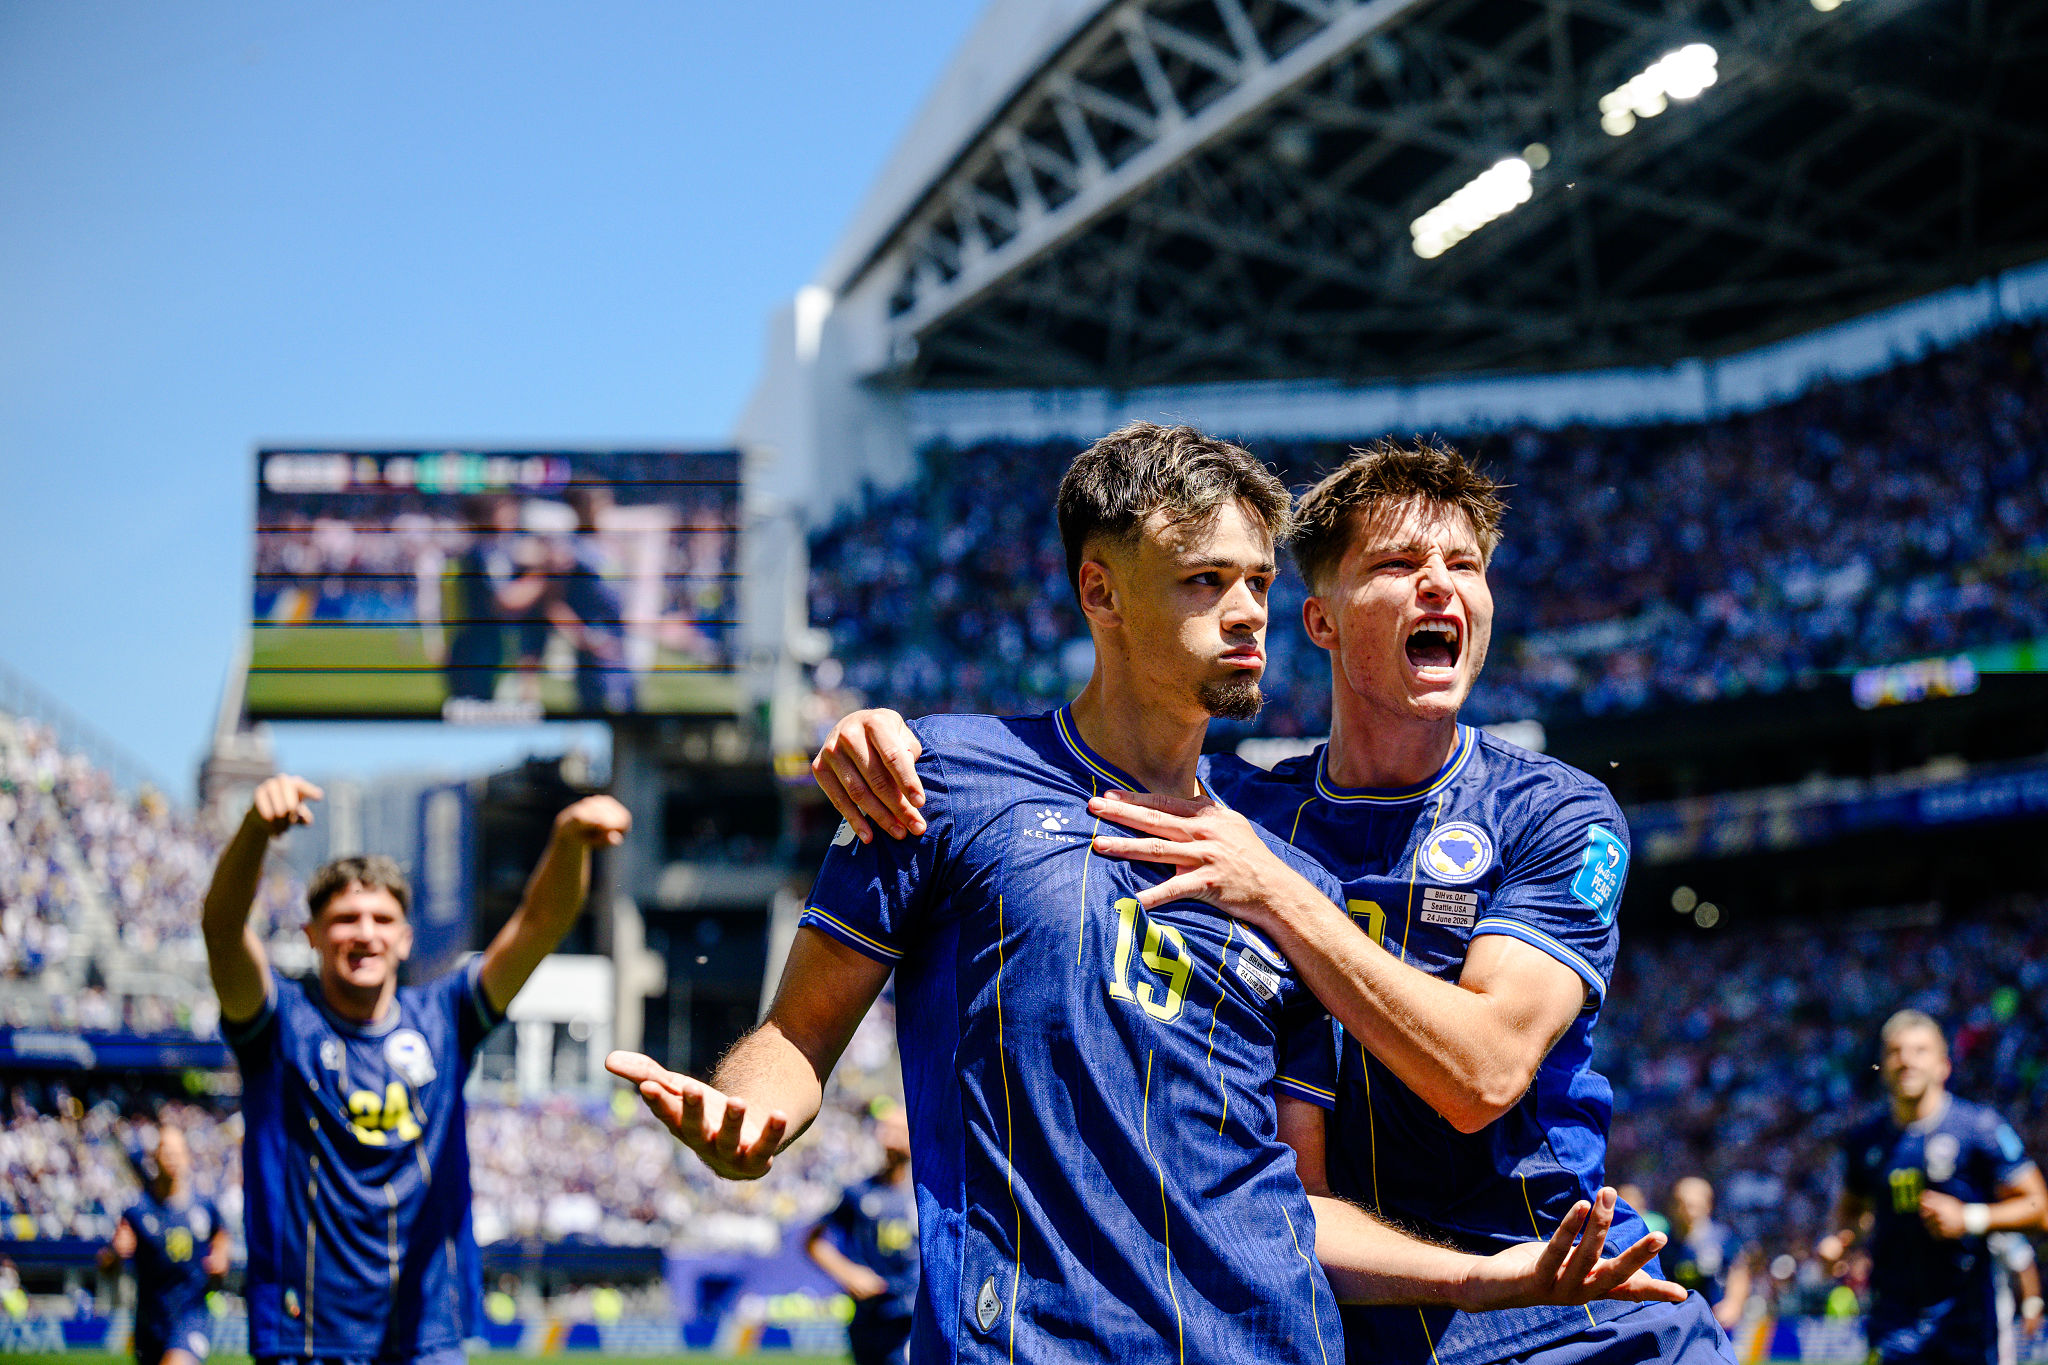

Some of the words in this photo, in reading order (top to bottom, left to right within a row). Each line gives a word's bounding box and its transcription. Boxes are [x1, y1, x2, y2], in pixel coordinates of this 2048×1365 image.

[1023, 828, 1077, 843] KELME
[1595, 860, 1611, 881] Unite
[1590, 874, 1613, 901] PEACE
[1434, 891, 1446, 899] BIH
[1454, 893, 1467, 902] QAT
[1591, 891, 1604, 906] FIFA
[1454, 904, 1467, 913] USA
[1426, 913, 1435, 921] 24
[1436, 914, 1452, 924] June
[1452, 916, 1468, 925] 2026
[1109, 897, 1195, 1025] 19
[1240, 969, 1248, 980] 24
[1246, 976, 1259, 989] June
[346, 1081, 422, 1146] 24
